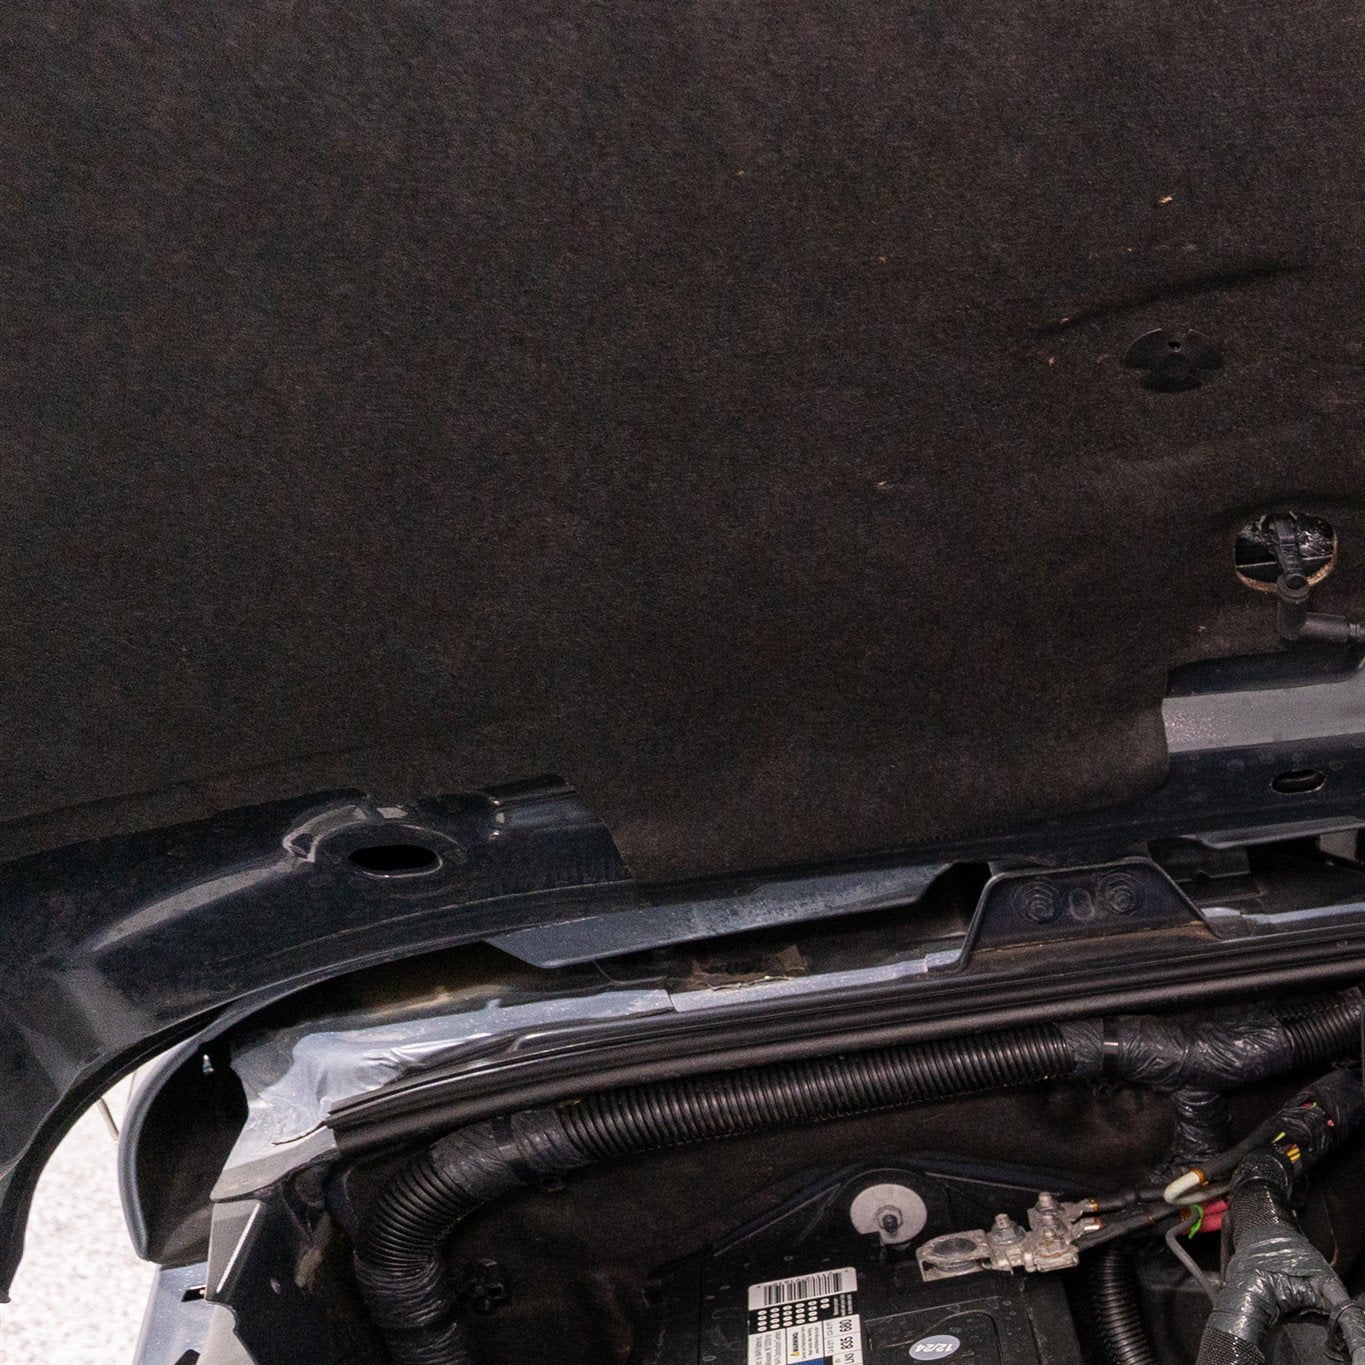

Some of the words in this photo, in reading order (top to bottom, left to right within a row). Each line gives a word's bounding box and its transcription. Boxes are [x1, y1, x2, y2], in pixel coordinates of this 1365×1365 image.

[839, 1319, 852, 1333] 680
[840, 1336, 853, 1350] 835
[915, 1343, 953, 1352] 12/24
